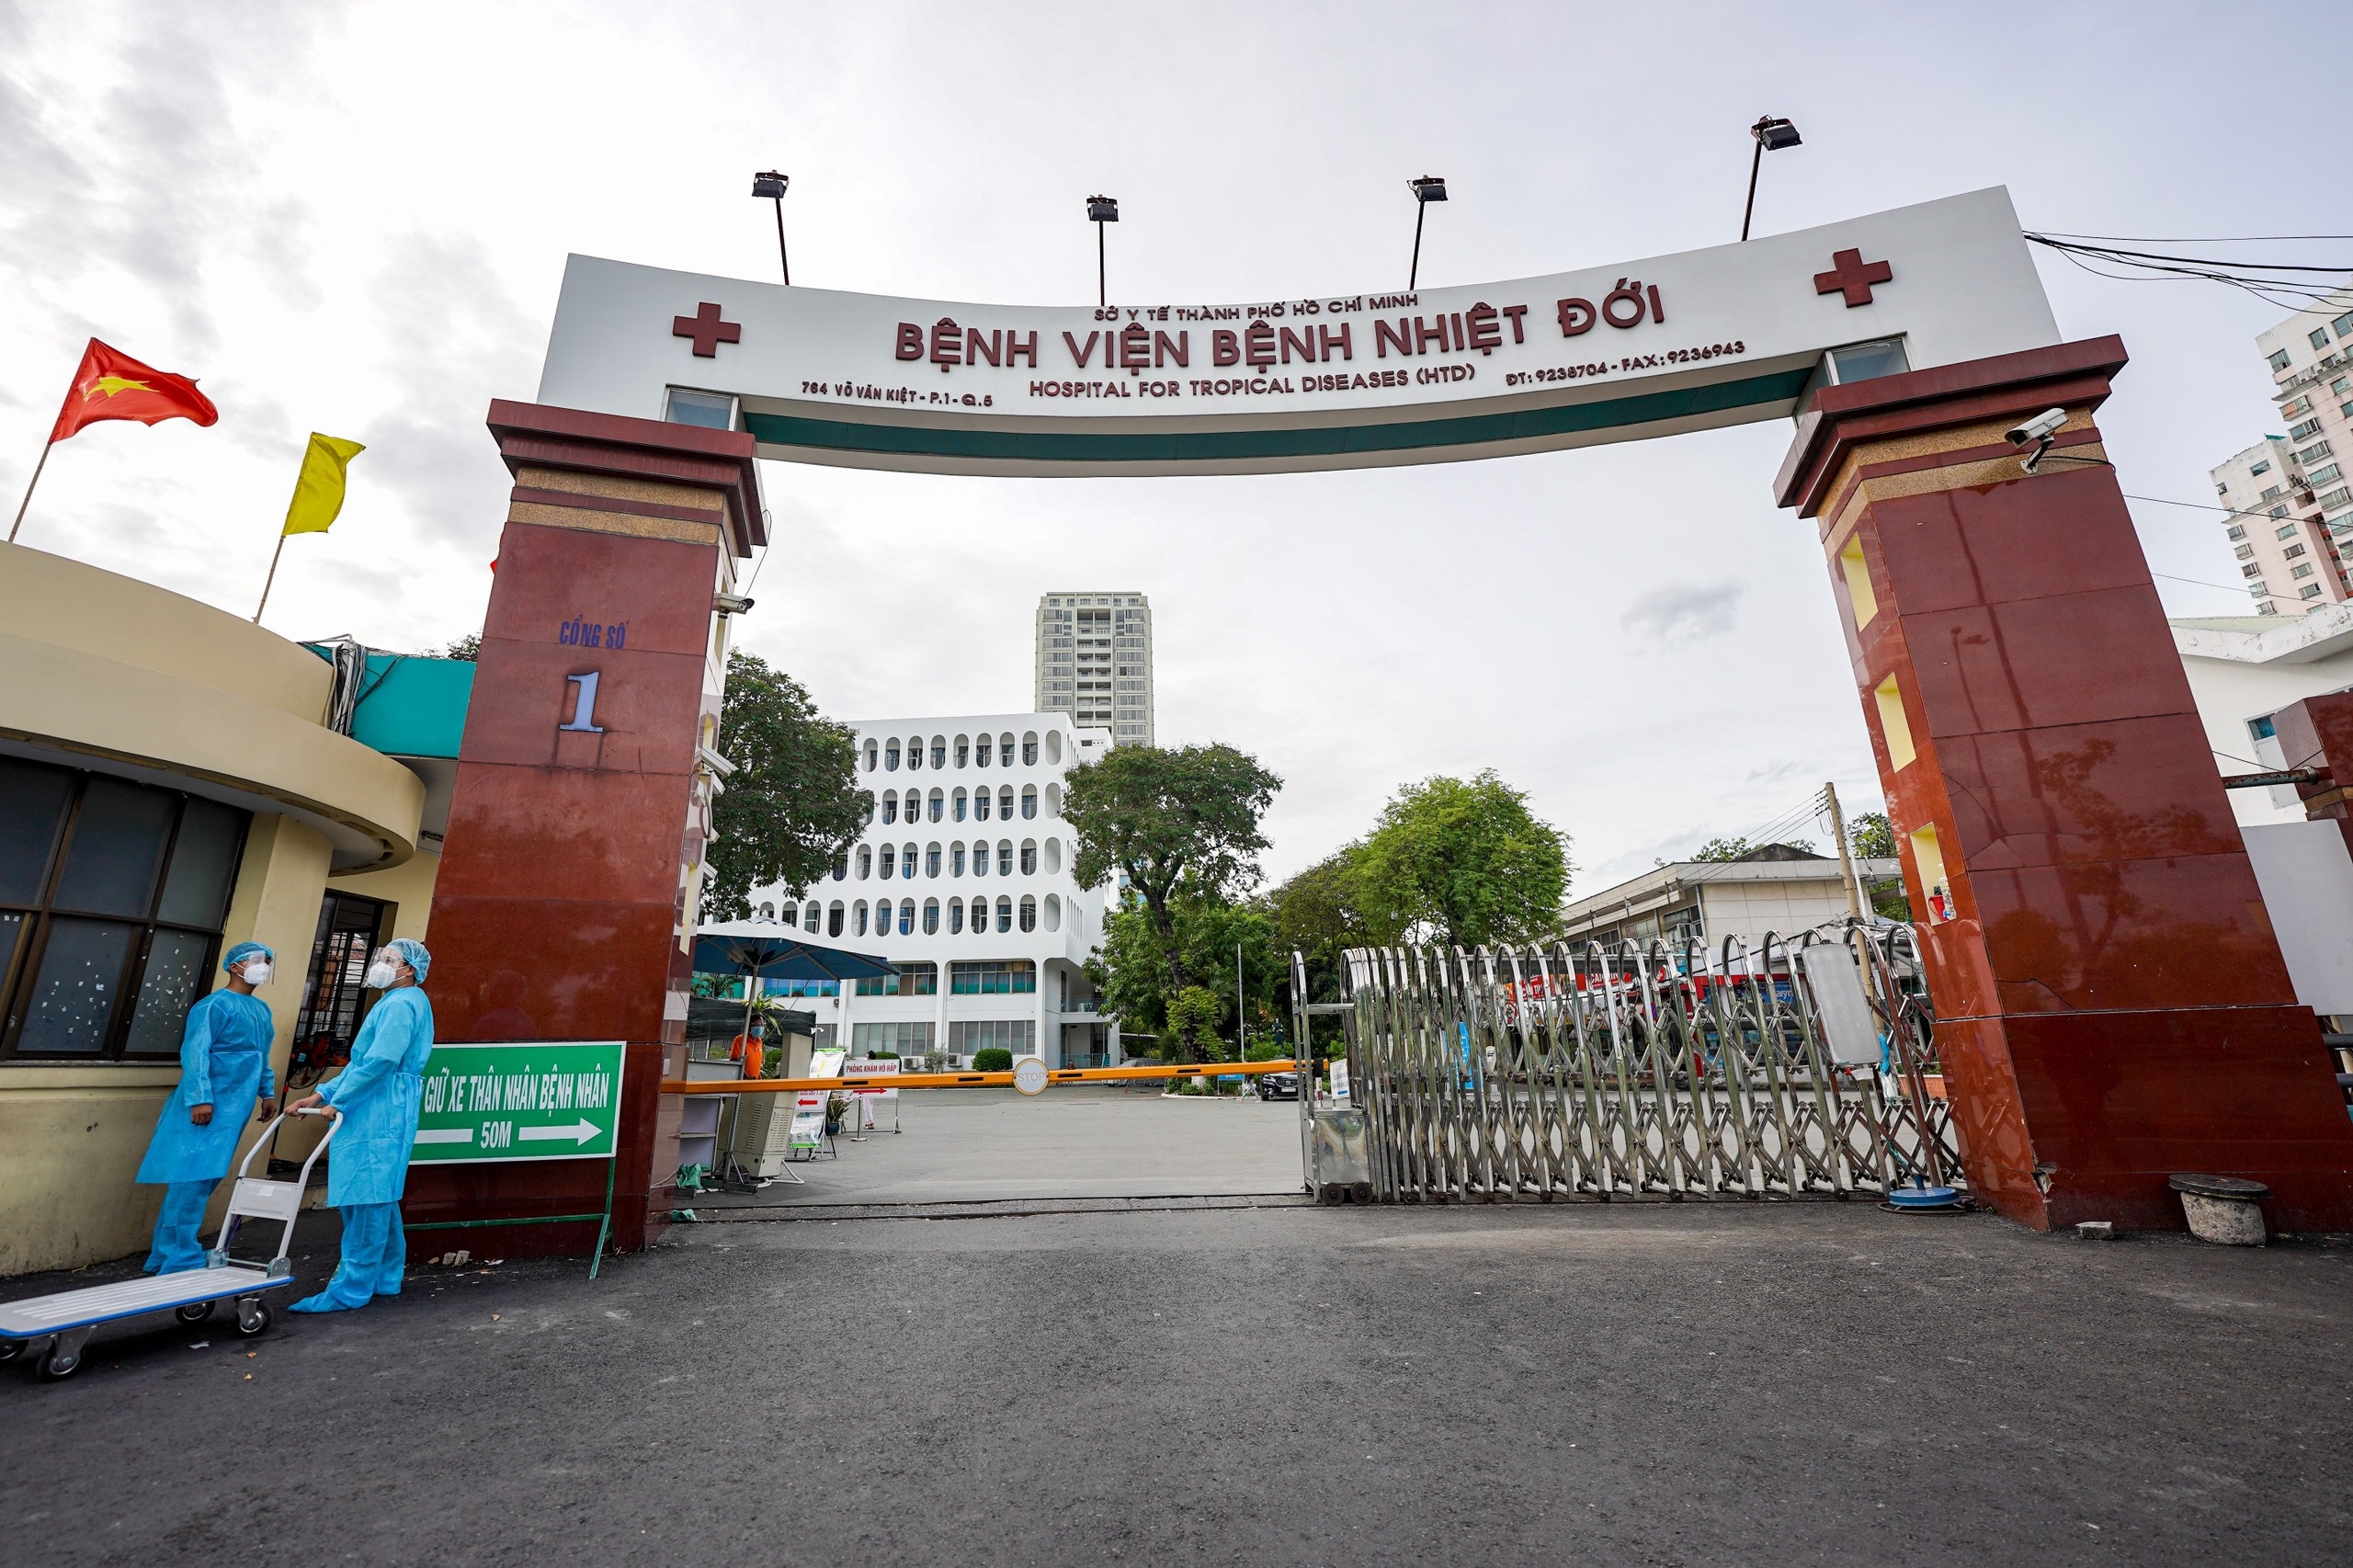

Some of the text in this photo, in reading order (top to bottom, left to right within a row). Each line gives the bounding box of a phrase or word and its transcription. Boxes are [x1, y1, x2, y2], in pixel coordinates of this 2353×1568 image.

[1094, 293, 1418, 321] SỞ Y TẾ THÀNH PHỐ HỒ CHÍ MINH
[895, 278, 1665, 376] BỆNH VIỆN BỆNH NHIỆT ĐỚI
[801, 381, 827, 394] 764
[835, 381, 853, 396] VÕ
[856, 383, 882, 400] VĂN
[886, 387, 917, 404] KIỆT
[1029, 362, 1475, 397] HOSPITAL FOR TROPICAL DISEASES (HTD)
[559, 614, 631, 650] CỔNG SỐ
[559, 671, 605, 733] 1
[846, 1062, 863, 1074] PHÒNG
[864, 1062, 878, 1073] KHÁM
[1017, 1072, 1045, 1083] STOP
[424, 1062, 610, 1118] GIỮ XE THÂN NHÂN BỆNH NHÂN
[480, 1120, 513, 1149] 50M
